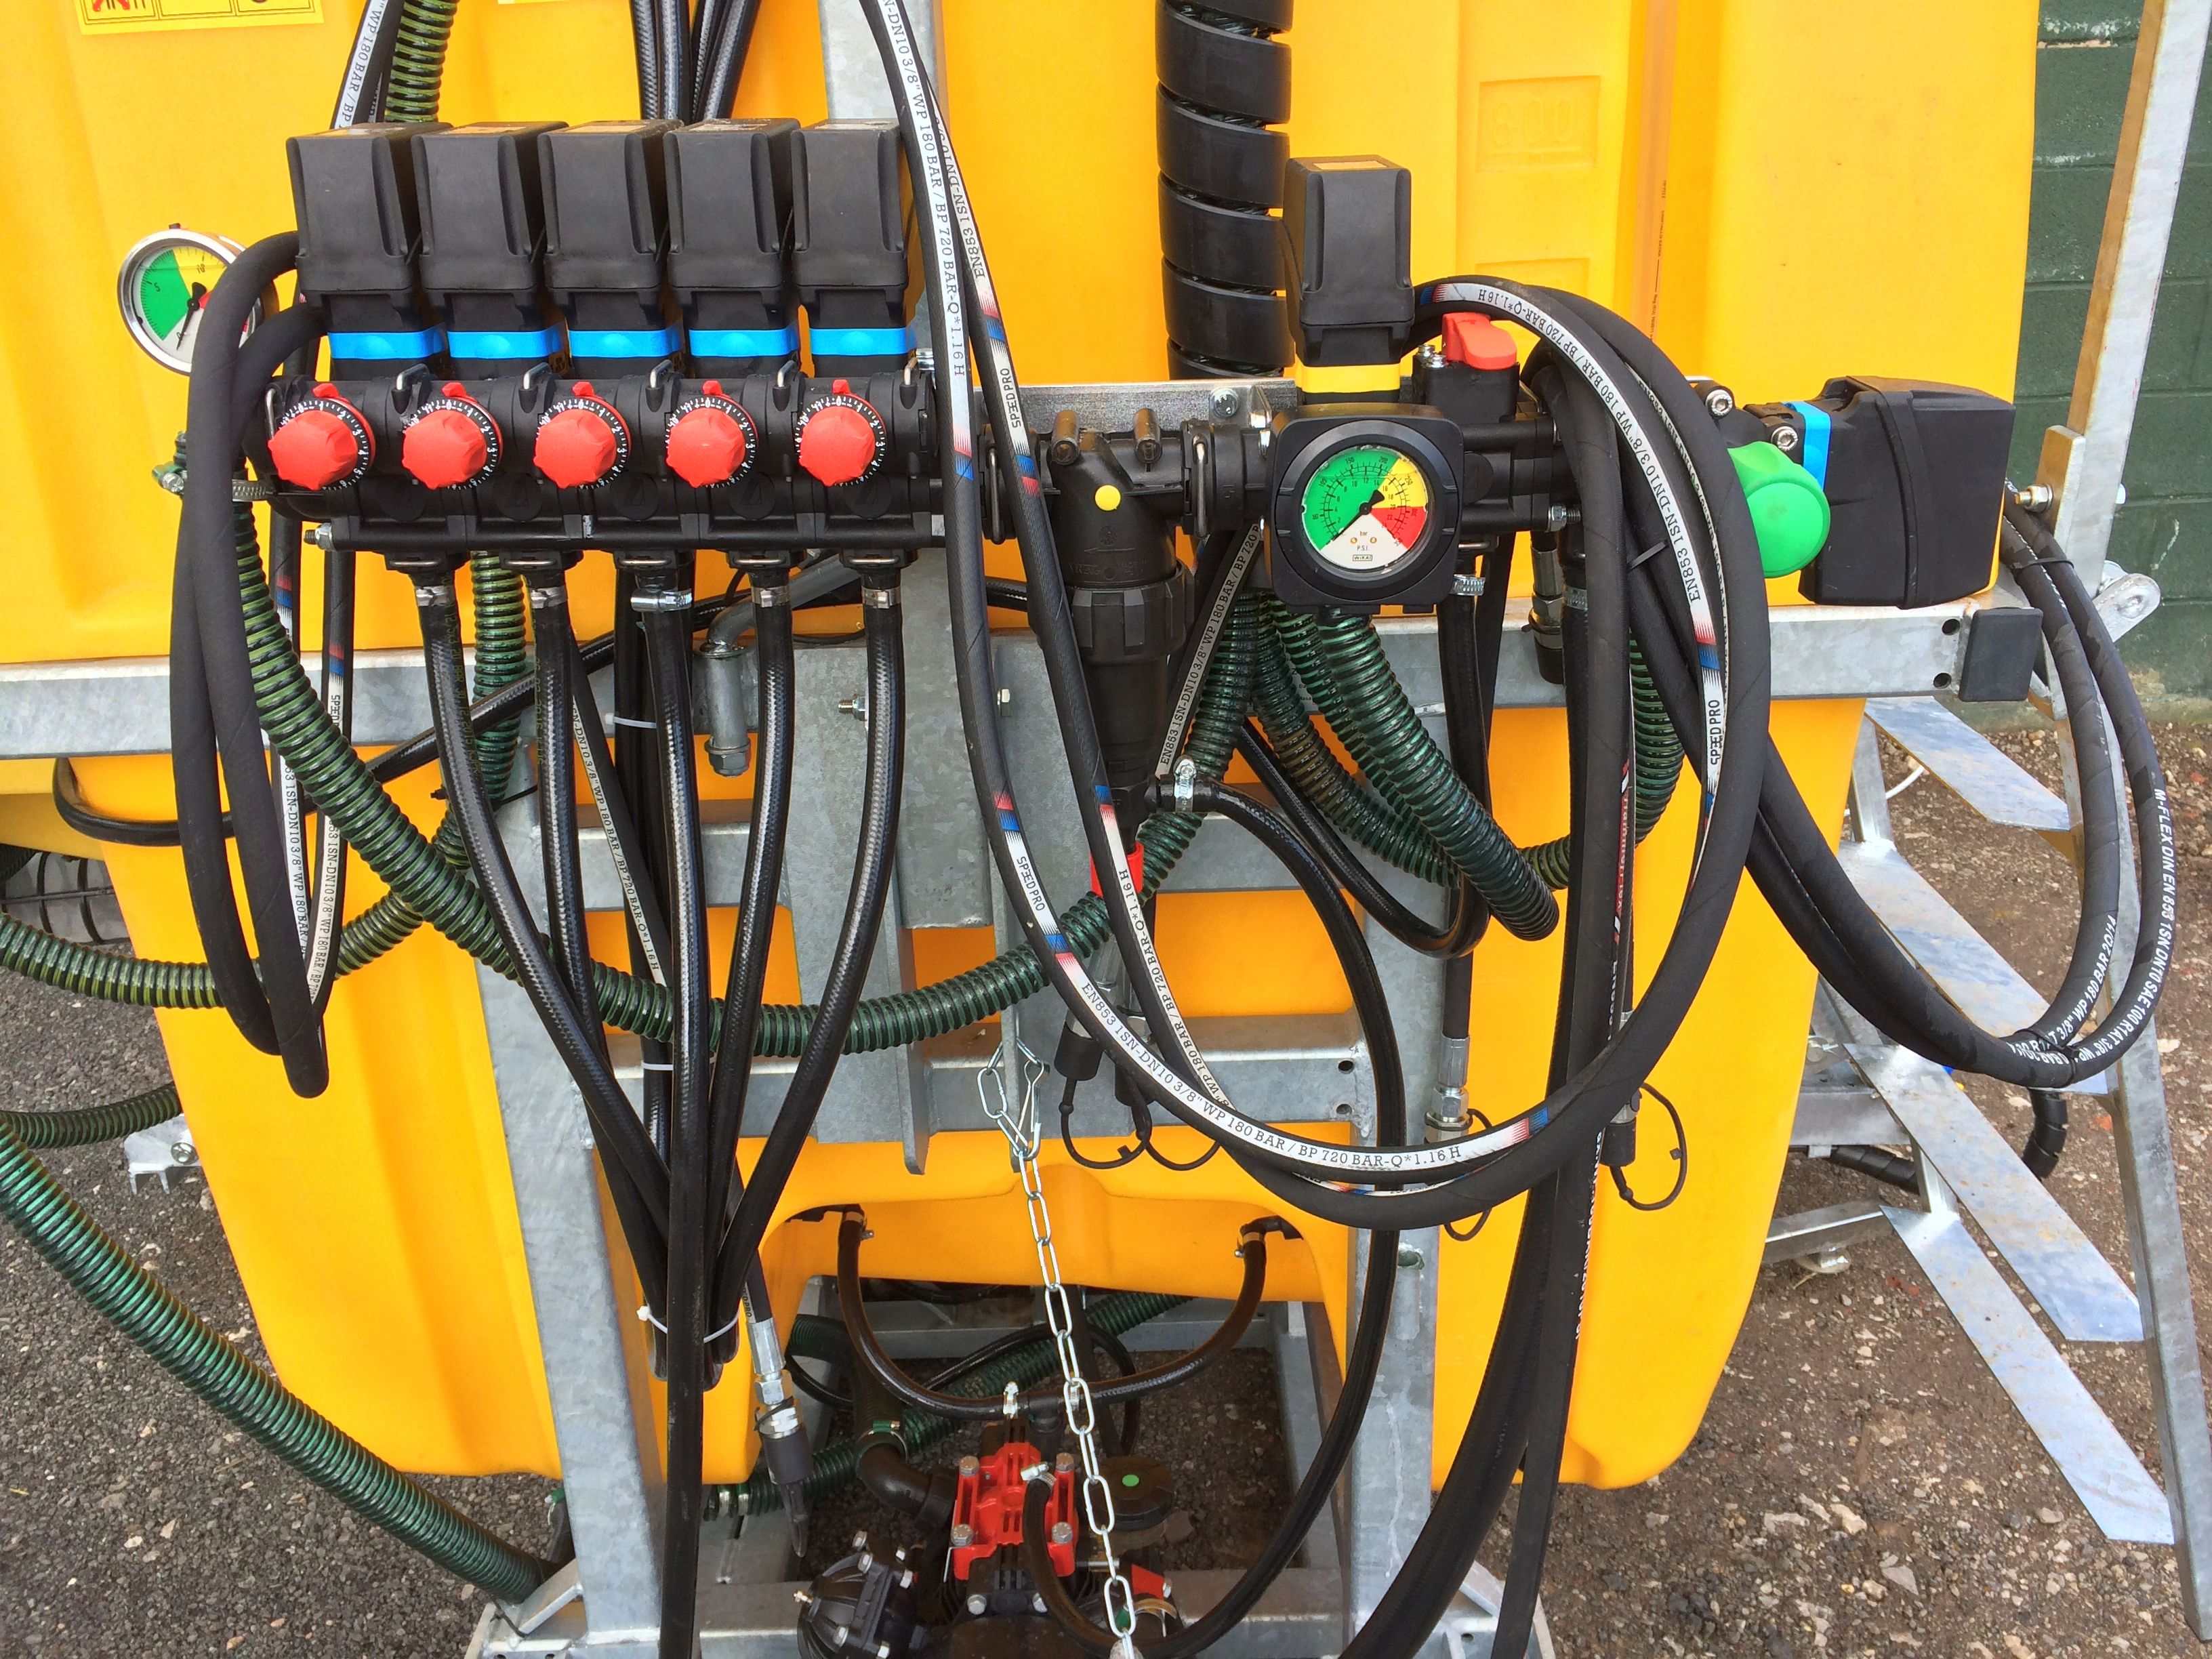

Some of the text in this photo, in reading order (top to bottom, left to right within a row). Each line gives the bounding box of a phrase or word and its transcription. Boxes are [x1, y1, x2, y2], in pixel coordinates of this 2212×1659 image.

[367, 10, 382, 33] WP
[358, 36, 373, 60] 180
[350, 62, 365, 91] BAR
[342, 103, 354, 122] BP
[913, 93, 928, 119] WP
[920, 125, 935, 151] 180
[927, 156, 943, 188] BAR
[935, 203, 948, 224] BP
[939, 228, 953, 257] 720
[963, 228, 985, 278] EN853
[154, 282, 161, 292] 5
[1546, 324, 1565, 345] 720
[1563, 342, 1578, 359] BP
[1582, 359, 1603, 389] BAR
[1600, 385, 1618, 411] 180
[1616, 411, 1633, 436] WP
[1677, 548, 1701, 603] EN853
[1160, 729, 1179, 765] EN853
[1202, 626, 1215, 644] WP
[1210, 604, 1225, 624] 180
[1219, 579, 1235, 602] BAR
[1234, 556, 1246, 571] BP
[1242, 534, 1258, 554] 720
[2154, 788, 2173, 845] M-FLEX
[593, 785, 605, 805] WP
[600, 806, 611, 826] 180
[607, 826, 620, 850] BAR
[617, 860, 628, 875] BP
[623, 876, 635, 895] 720
[2162, 845, 2175, 874] DIN
[293, 872, 304, 891] WP
[2163, 873, 2175, 895] EN
[295, 894, 307, 914] 180
[319, 918, 331, 935] WP
[2157, 922, 2173, 950] 1SN
[317, 935, 329, 952] 180
[314, 952, 327, 968] BAR
[2149, 948, 2170, 983] DN10
[1152, 967, 1167, 991] 720
[2072, 999, 2087, 1022] WP
[2084, 981, 2099, 1003] 180
[2094, 952, 2109, 985] BAR
[1162, 994, 1175, 1010] BP
[2137, 981, 2158, 1008] SAE
[2126, 1004, 2146, 1024] 100
[1174, 1021, 1193, 1048] BAR
[2107, 1019, 2135, 1046] R1AT
[1082, 983, 1117, 1026] EN853
[1203, 1101, 1226, 1121] WP
[1227, 1116, 1253, 1136] 180
[1254, 1130, 1286, 1151] BAR
[1298, 1145, 1318, 1158] BP
[1322, 1150, 1347, 1164] 720
[1188, 1050, 1206, 1071] 180
[1202, 1074, 1219, 1094] WP
